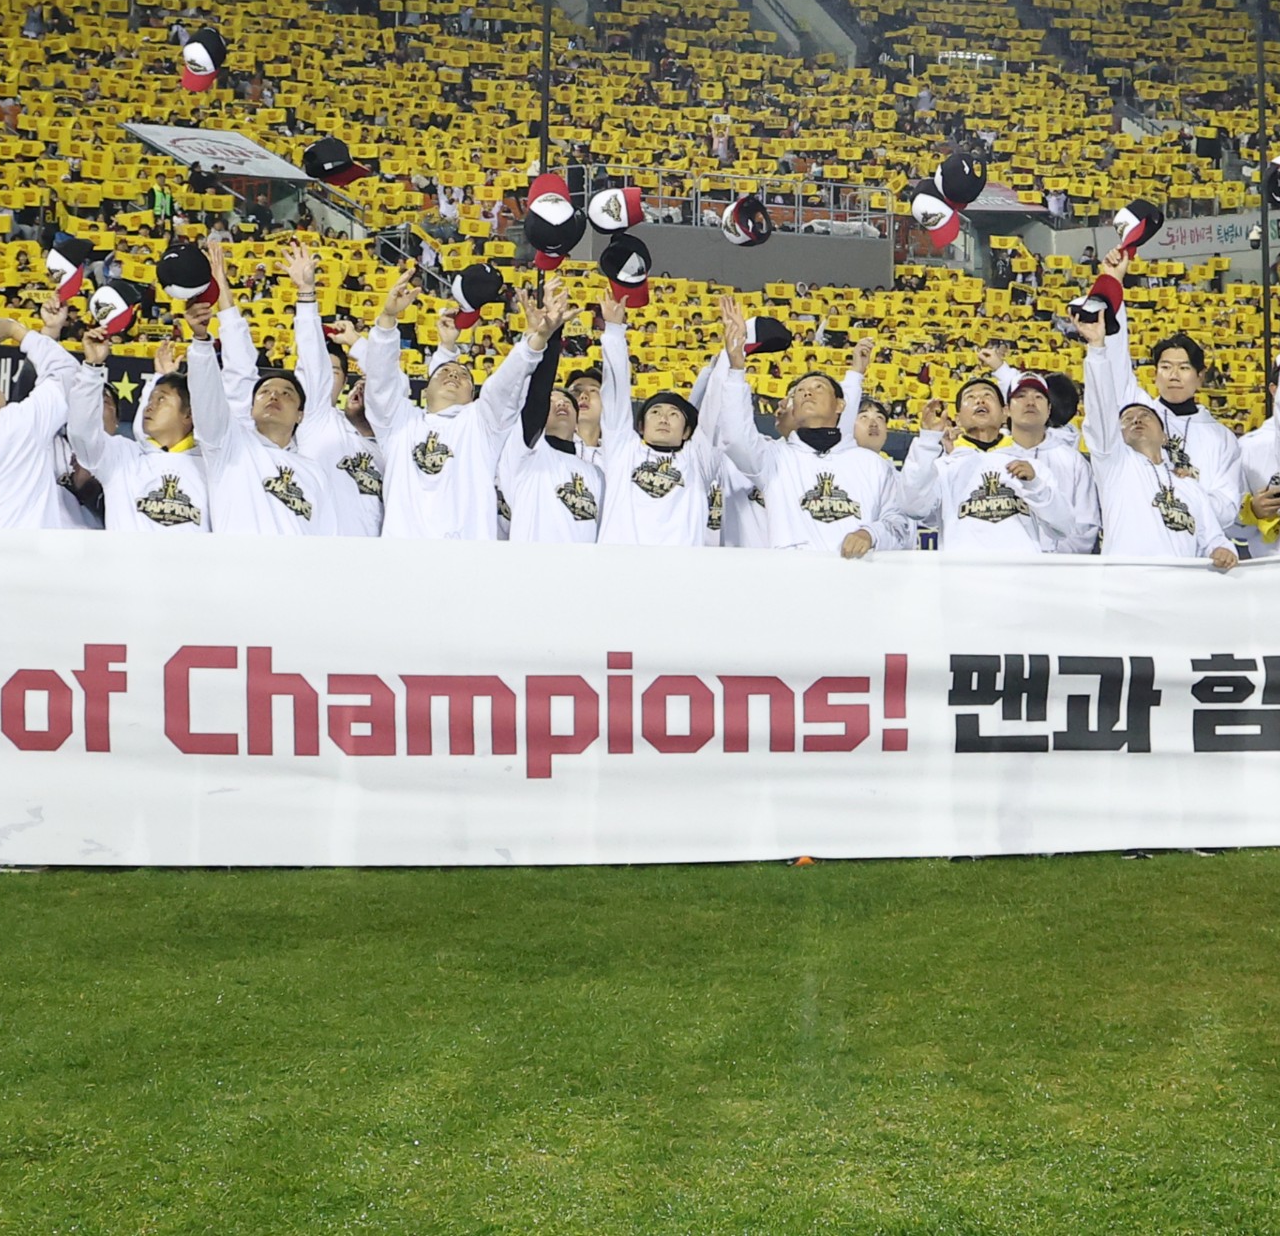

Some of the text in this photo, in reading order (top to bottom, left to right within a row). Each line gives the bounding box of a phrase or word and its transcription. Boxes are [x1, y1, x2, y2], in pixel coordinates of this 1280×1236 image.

[958, 497, 1030, 520] CHAMPIONS
[0, 644, 127, 752] of
[164, 646, 908, 779] Champions!
[948, 654, 1162, 753] 팬과
